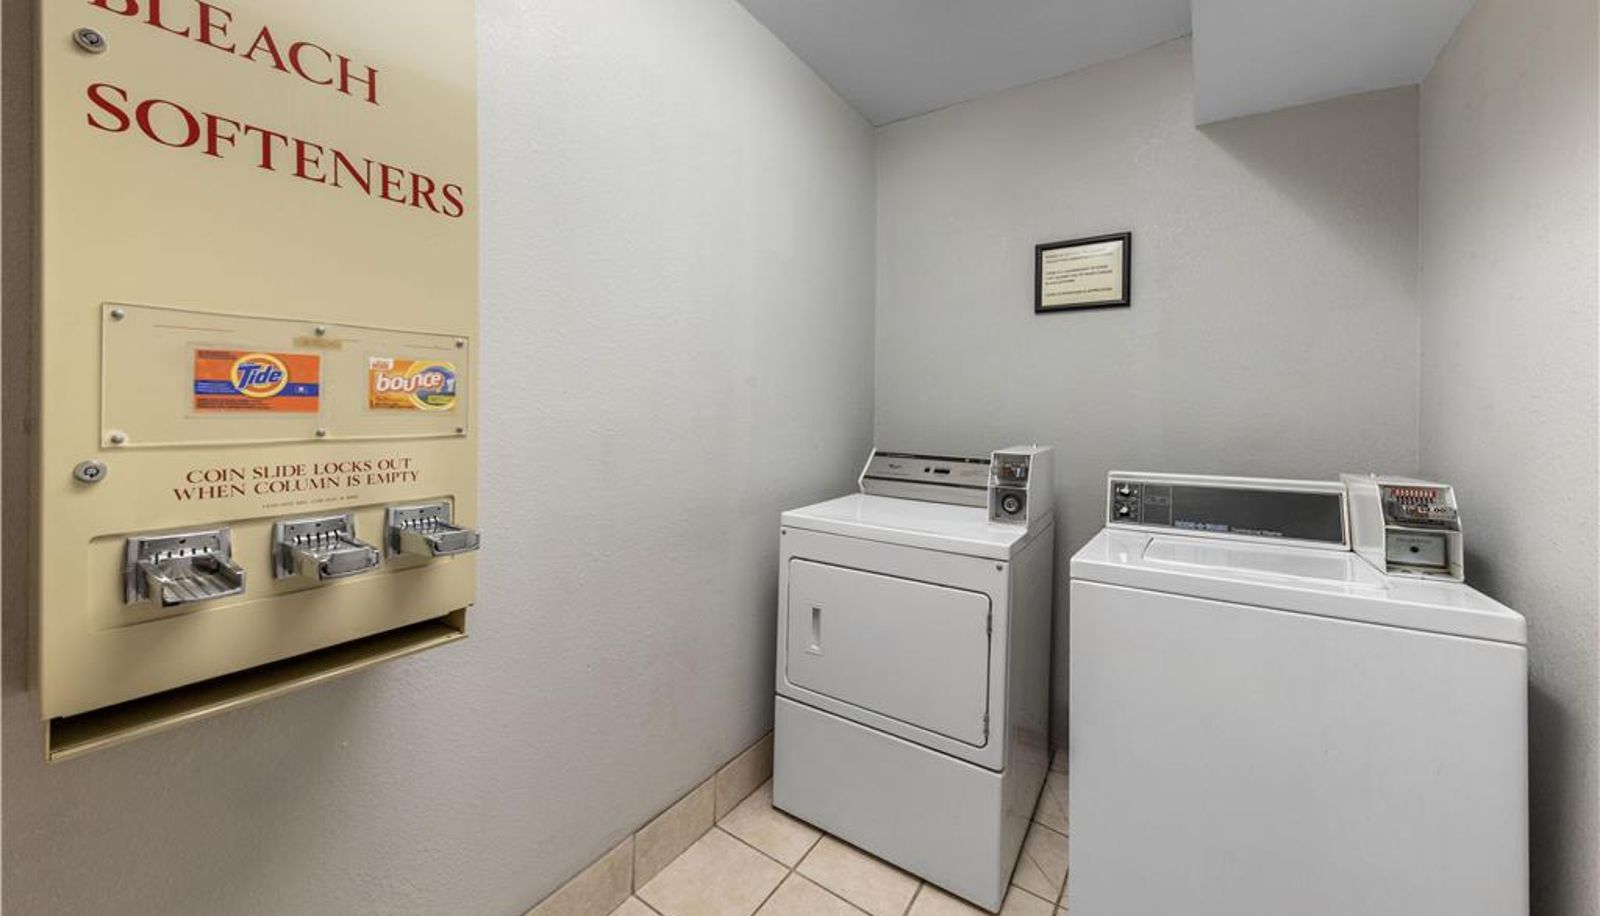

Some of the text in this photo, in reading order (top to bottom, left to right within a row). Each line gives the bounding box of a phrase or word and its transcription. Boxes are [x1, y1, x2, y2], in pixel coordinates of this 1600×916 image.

[86, 83, 465, 218] SOFTENERS
[236, 362, 283, 390] Tide
[376, 371, 446, 393] bounce
[186, 457, 411, 484] COIN SLIDE LOCKS OUT
[173, 470, 419, 501] WHEN COLUMN IS EMPTY
